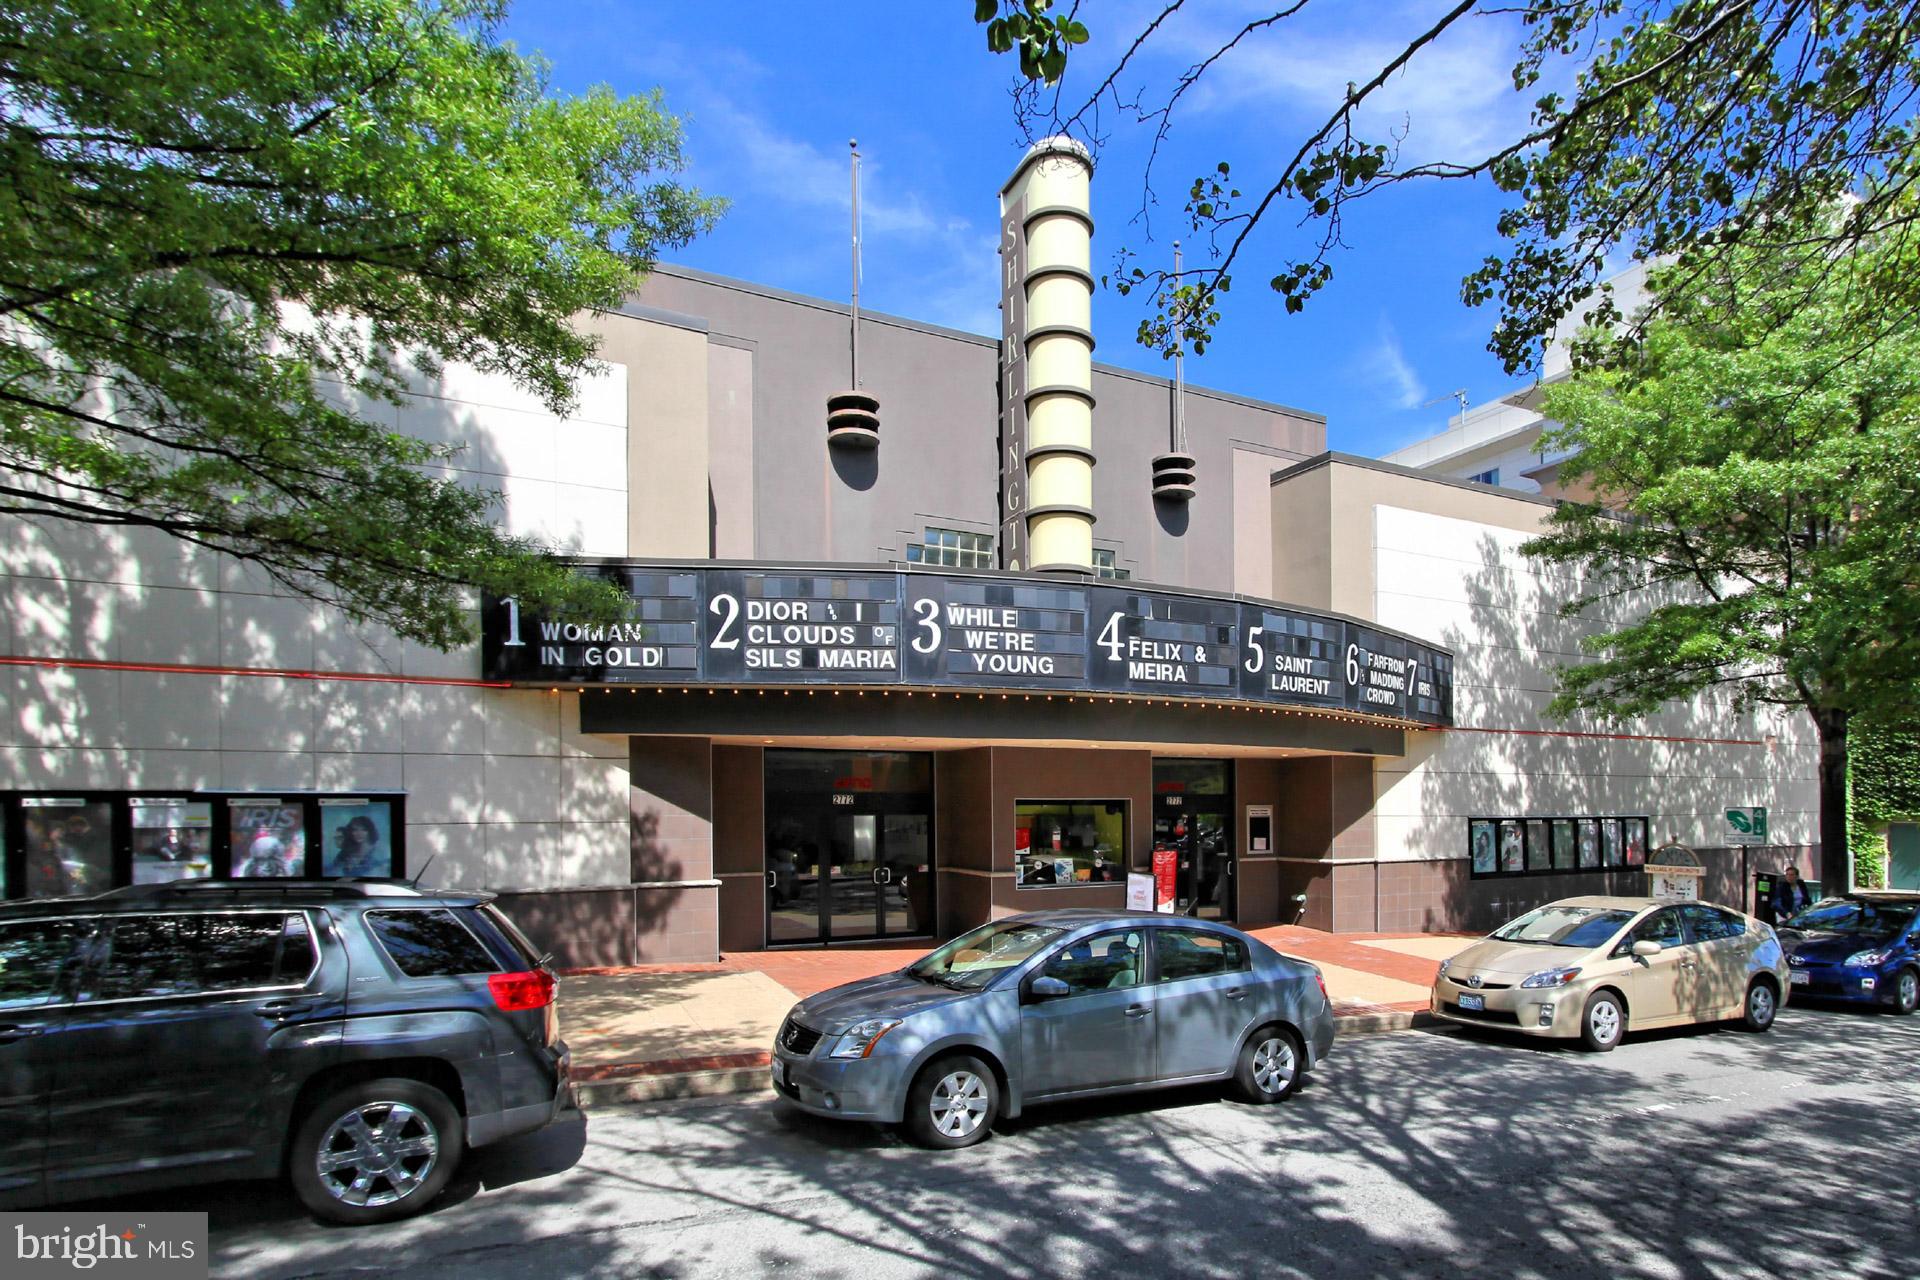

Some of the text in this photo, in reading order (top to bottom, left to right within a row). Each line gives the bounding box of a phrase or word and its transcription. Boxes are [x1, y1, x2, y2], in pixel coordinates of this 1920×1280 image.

[500, 596, 526, 646] 1
[709, 593, 740, 650] 2
[746, 601, 808, 621] DIOR
[855, 602, 862, 622] I
[947, 605, 1016, 628] WHILE
[541, 621, 642, 643] WOMAN
[747, 625, 893, 646] CLOUDS OF
[911, 598, 942, 653] 3
[1096, 611, 1126, 662] 4
[965, 630, 1034, 651] WE'RE
[1129, 639, 1207, 664] FELIX &
[1244, 626, 1264, 673] 5
[541, 646, 660, 667] IN GOLD
[746, 648, 896, 668] SILS MARIA
[972, 653, 1054, 675] YOUNG
[1275, 655, 1313, 675] SAINT
[1346, 643, 1359, 686] 6
[1129, 661, 1187, 682] MEIRA
[1370, 670, 1405, 691] MADDING
[1407, 658, 1418, 697] 7
[1271, 673, 1331, 696] LAURENT
[1366, 687, 1396, 706] CROWD
